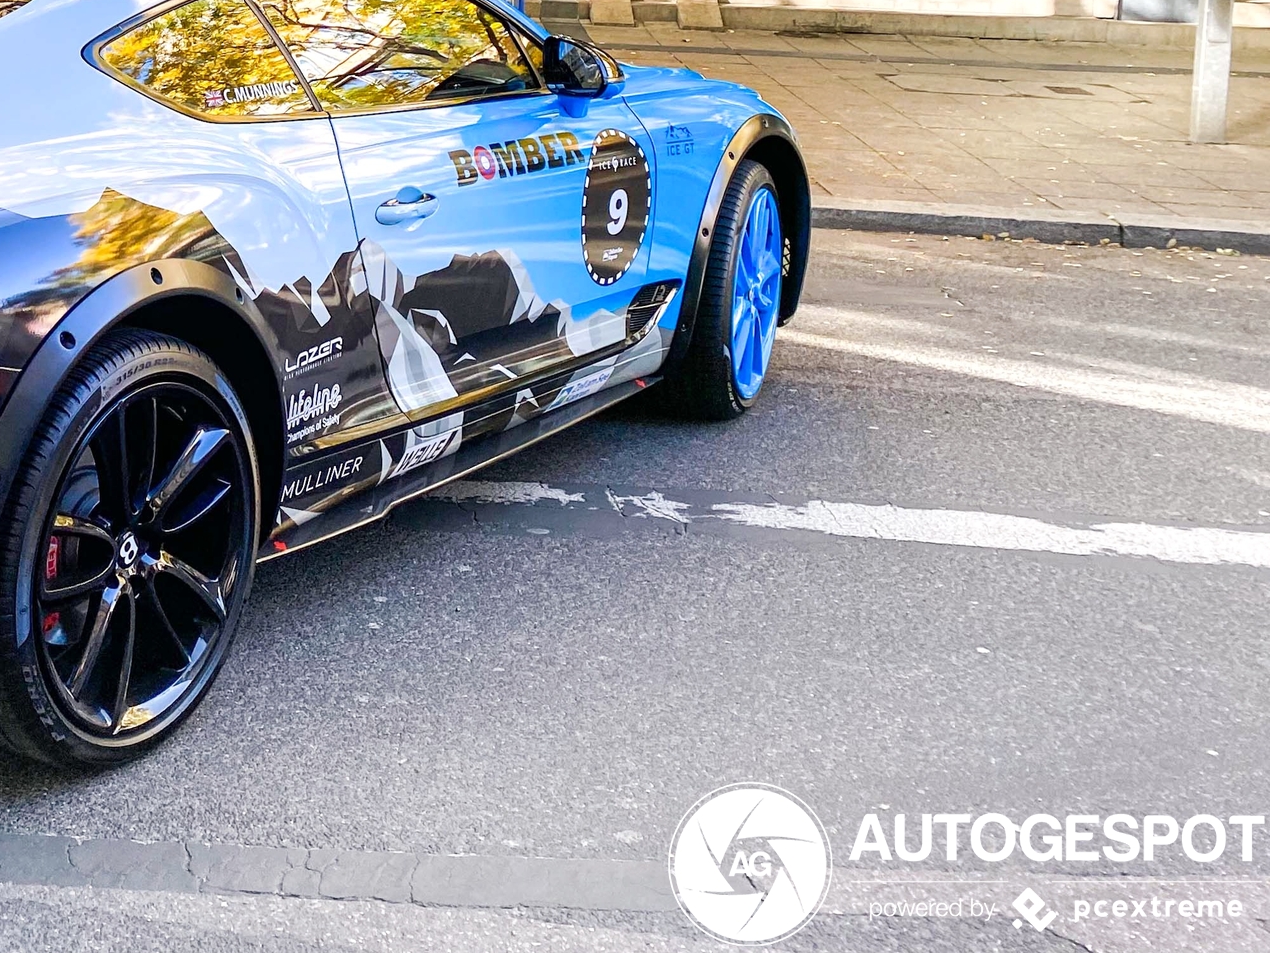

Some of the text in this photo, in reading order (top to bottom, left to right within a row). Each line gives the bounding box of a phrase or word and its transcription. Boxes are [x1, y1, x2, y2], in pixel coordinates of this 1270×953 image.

[449, 131, 585, 187] BOMBER
[599, 156, 637, 170] ICE RACE
[666, 142, 695, 156] ICE GT
[606, 188, 629, 236] 9
[285, 336, 343, 372] LAZER
[315, 419, 322, 431] of
[322, 413, 341, 428] Safety
[281, 456, 363, 502] MULLINER
